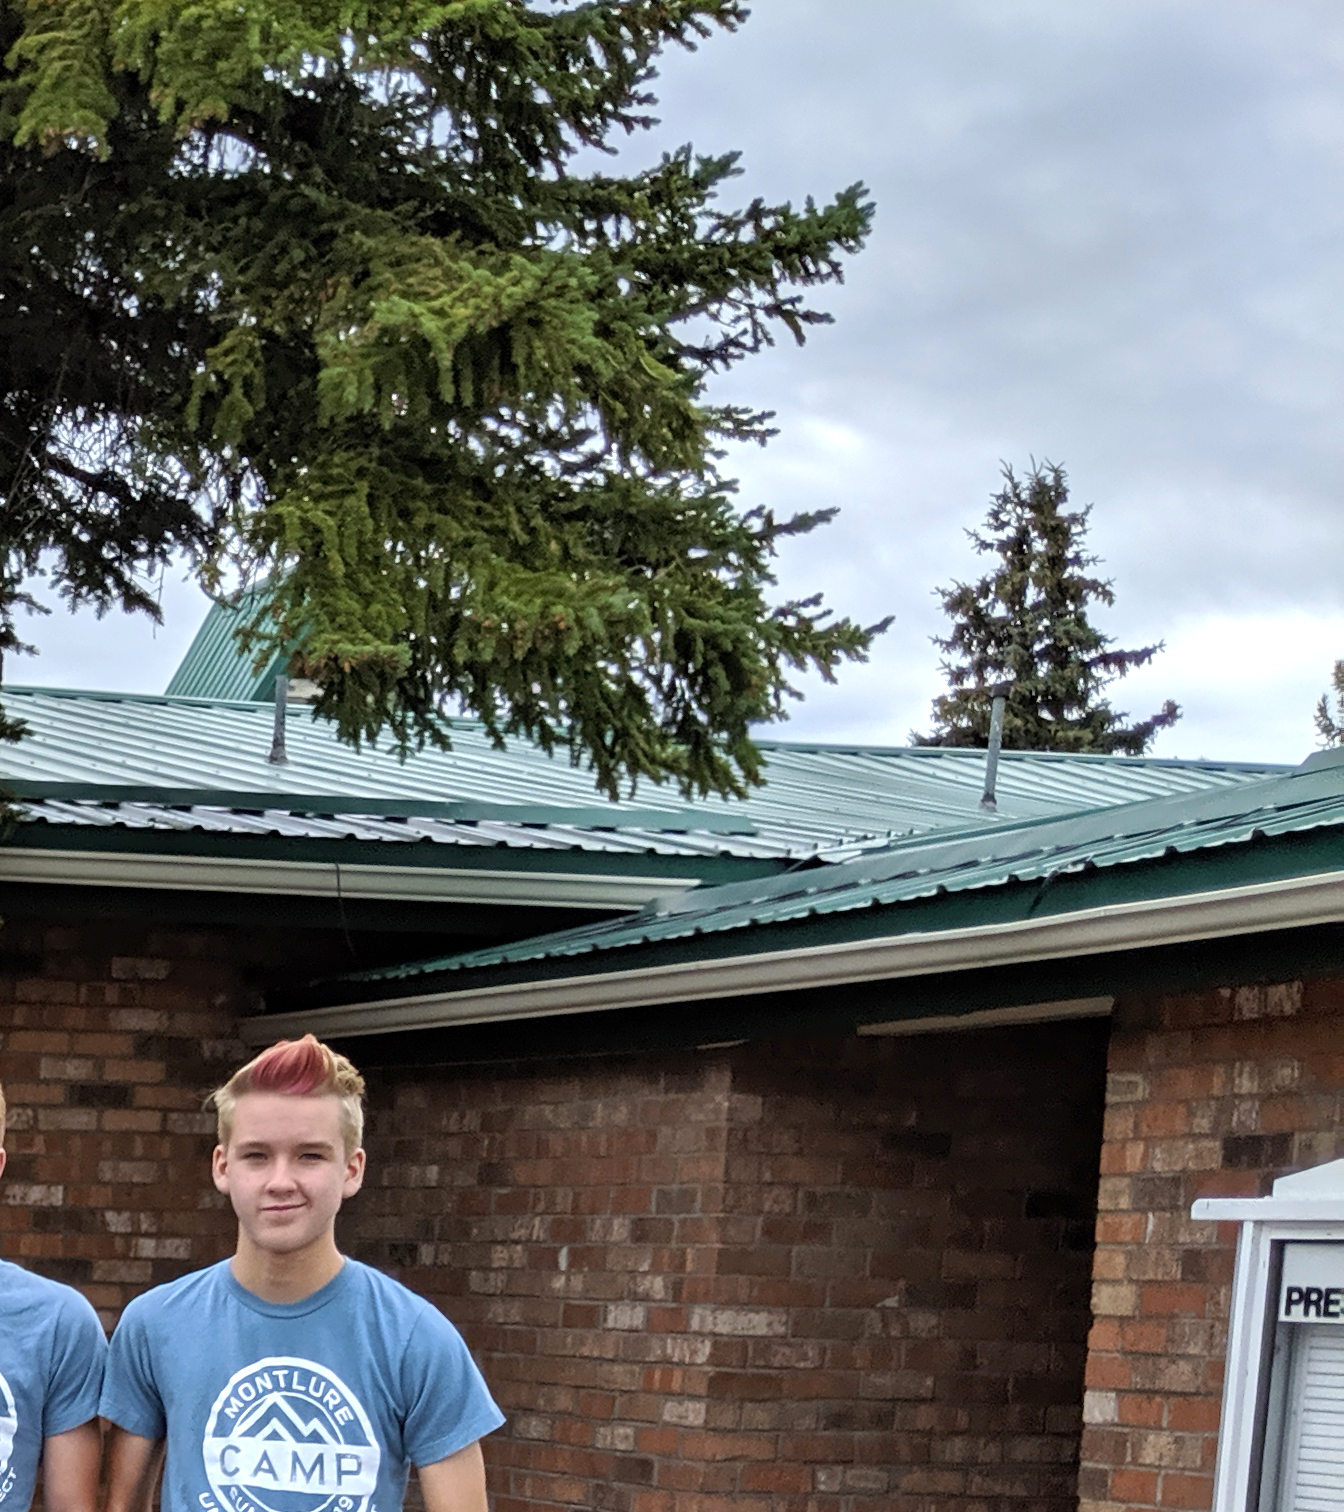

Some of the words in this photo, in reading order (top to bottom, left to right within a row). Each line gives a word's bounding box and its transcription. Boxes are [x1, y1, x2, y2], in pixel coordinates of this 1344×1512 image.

[1284, 1286, 1344, 1318] PRE
[224, 1370, 355, 1426] MONTLURE
[219, 1444, 363, 1487] CAMP
